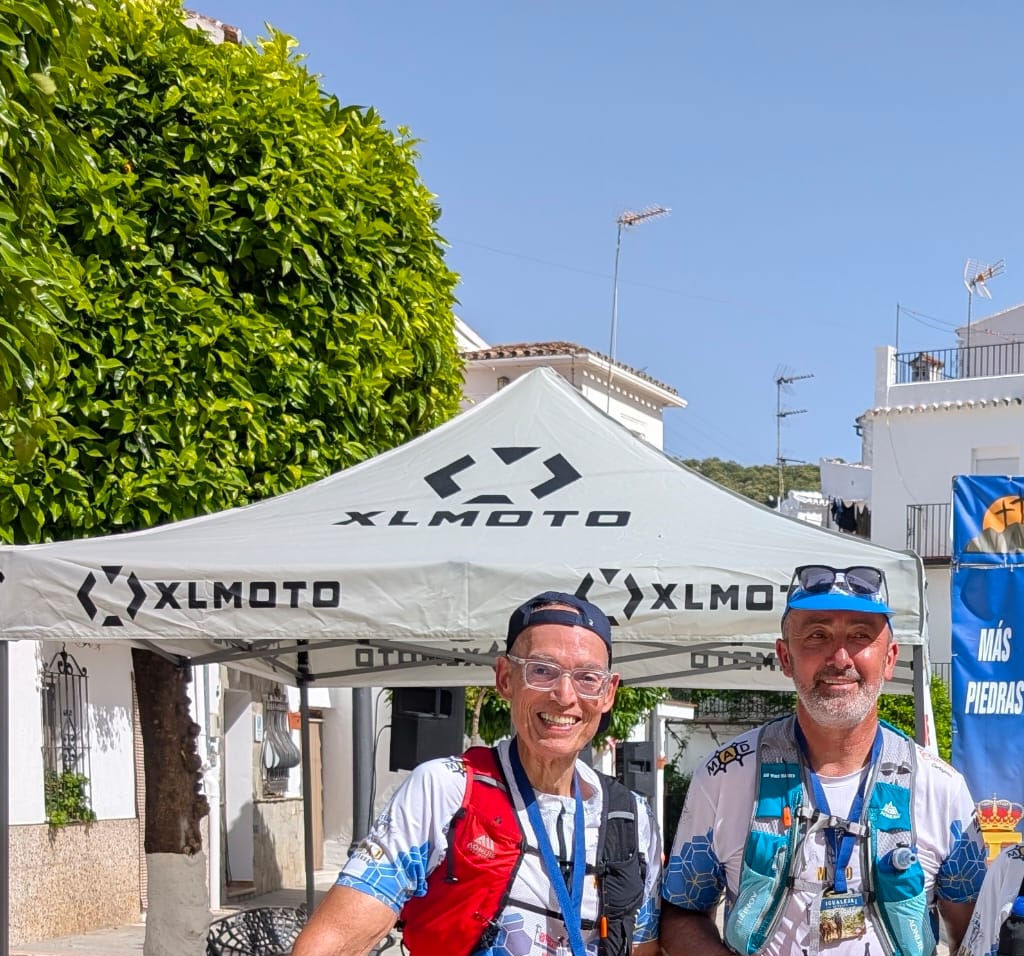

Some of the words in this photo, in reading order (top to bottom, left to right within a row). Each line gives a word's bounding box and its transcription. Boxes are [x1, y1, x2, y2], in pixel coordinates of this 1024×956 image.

[332, 510, 631, 527] XLMOTO
[153, 581, 341, 609] XLMOTO
[978, 620, 1012, 662] MÁS
[965, 681, 1024, 715] PIEDRAS
